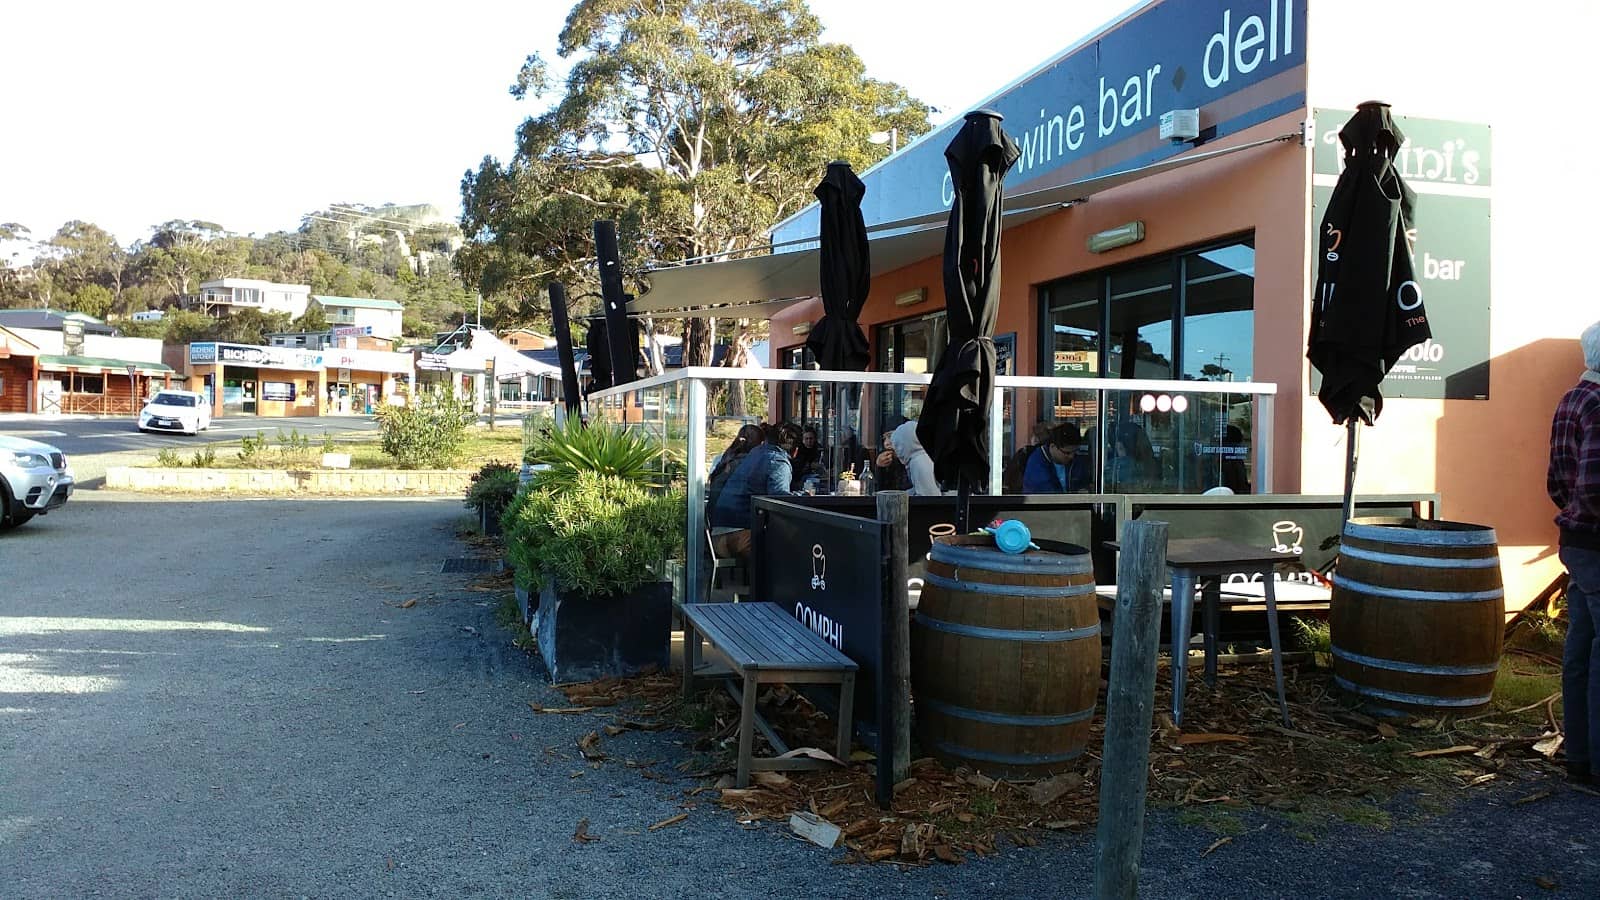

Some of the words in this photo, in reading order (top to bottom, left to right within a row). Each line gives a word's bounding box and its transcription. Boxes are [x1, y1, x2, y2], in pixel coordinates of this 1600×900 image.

[1016, 103, 1084, 175] wine
[1099, 64, 1161, 138] bar
[1423, 252, 1466, 280] bar
[1406, 315, 1426, 327] The
